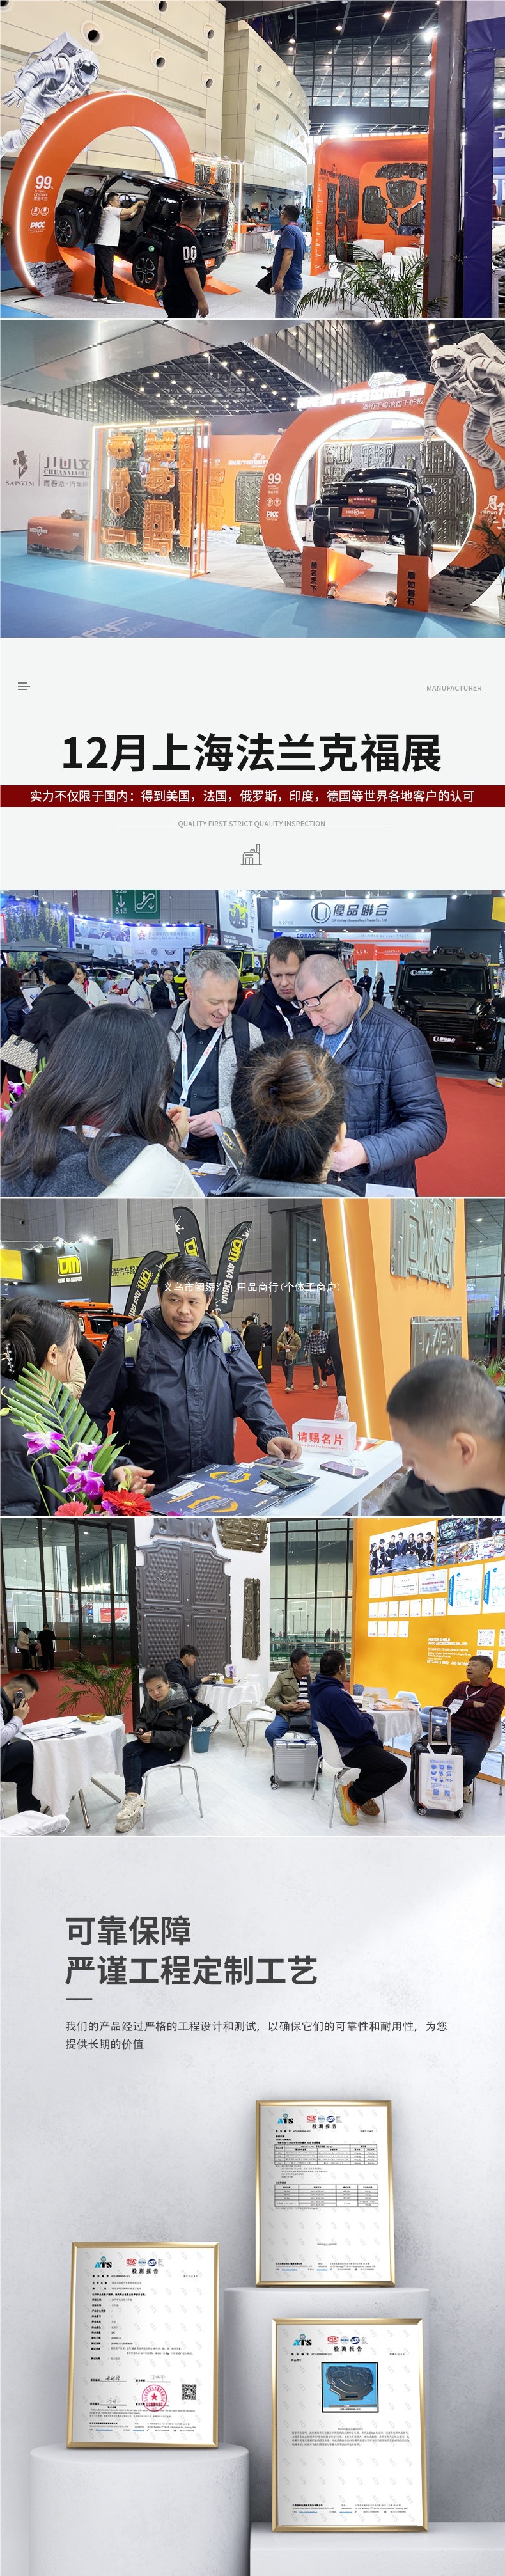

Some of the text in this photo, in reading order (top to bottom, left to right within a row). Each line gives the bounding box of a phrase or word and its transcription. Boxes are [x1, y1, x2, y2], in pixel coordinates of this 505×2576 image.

[361, 398, 424, 411] 适用于电池包下护板
[332, 904, 389, 916] 優品聯合
[298, 1431, 344, 1446] 请赐名片
